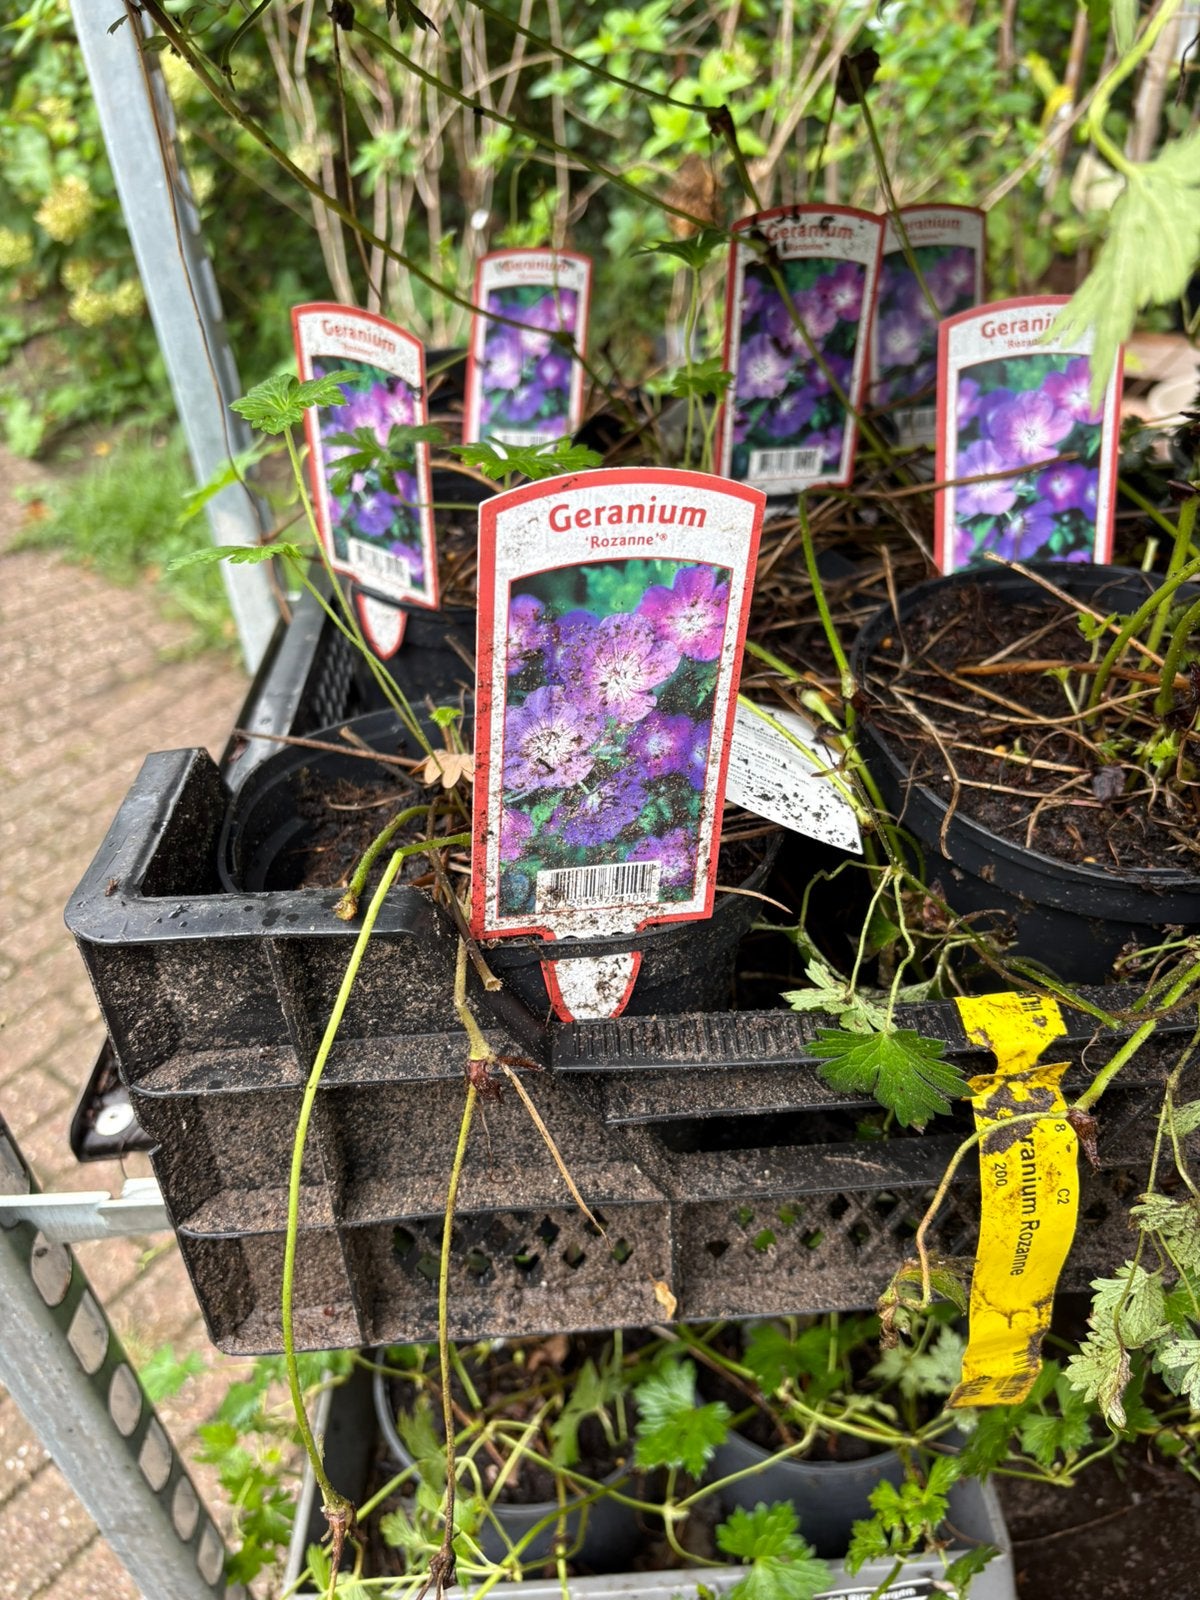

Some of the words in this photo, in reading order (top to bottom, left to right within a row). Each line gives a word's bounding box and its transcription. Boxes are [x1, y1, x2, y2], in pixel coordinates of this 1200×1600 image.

[321, 319, 397, 354] Geranium
[982, 312, 1070, 338] Gerani
[549, 496, 707, 532] Geranium
[994, 1162, 1007, 1187] 200
[1020, 1137, 1042, 1215] ranium
[1057, 1188, 1070, 1205] C2
[1010, 1220, 1040, 1276] Rozanne
